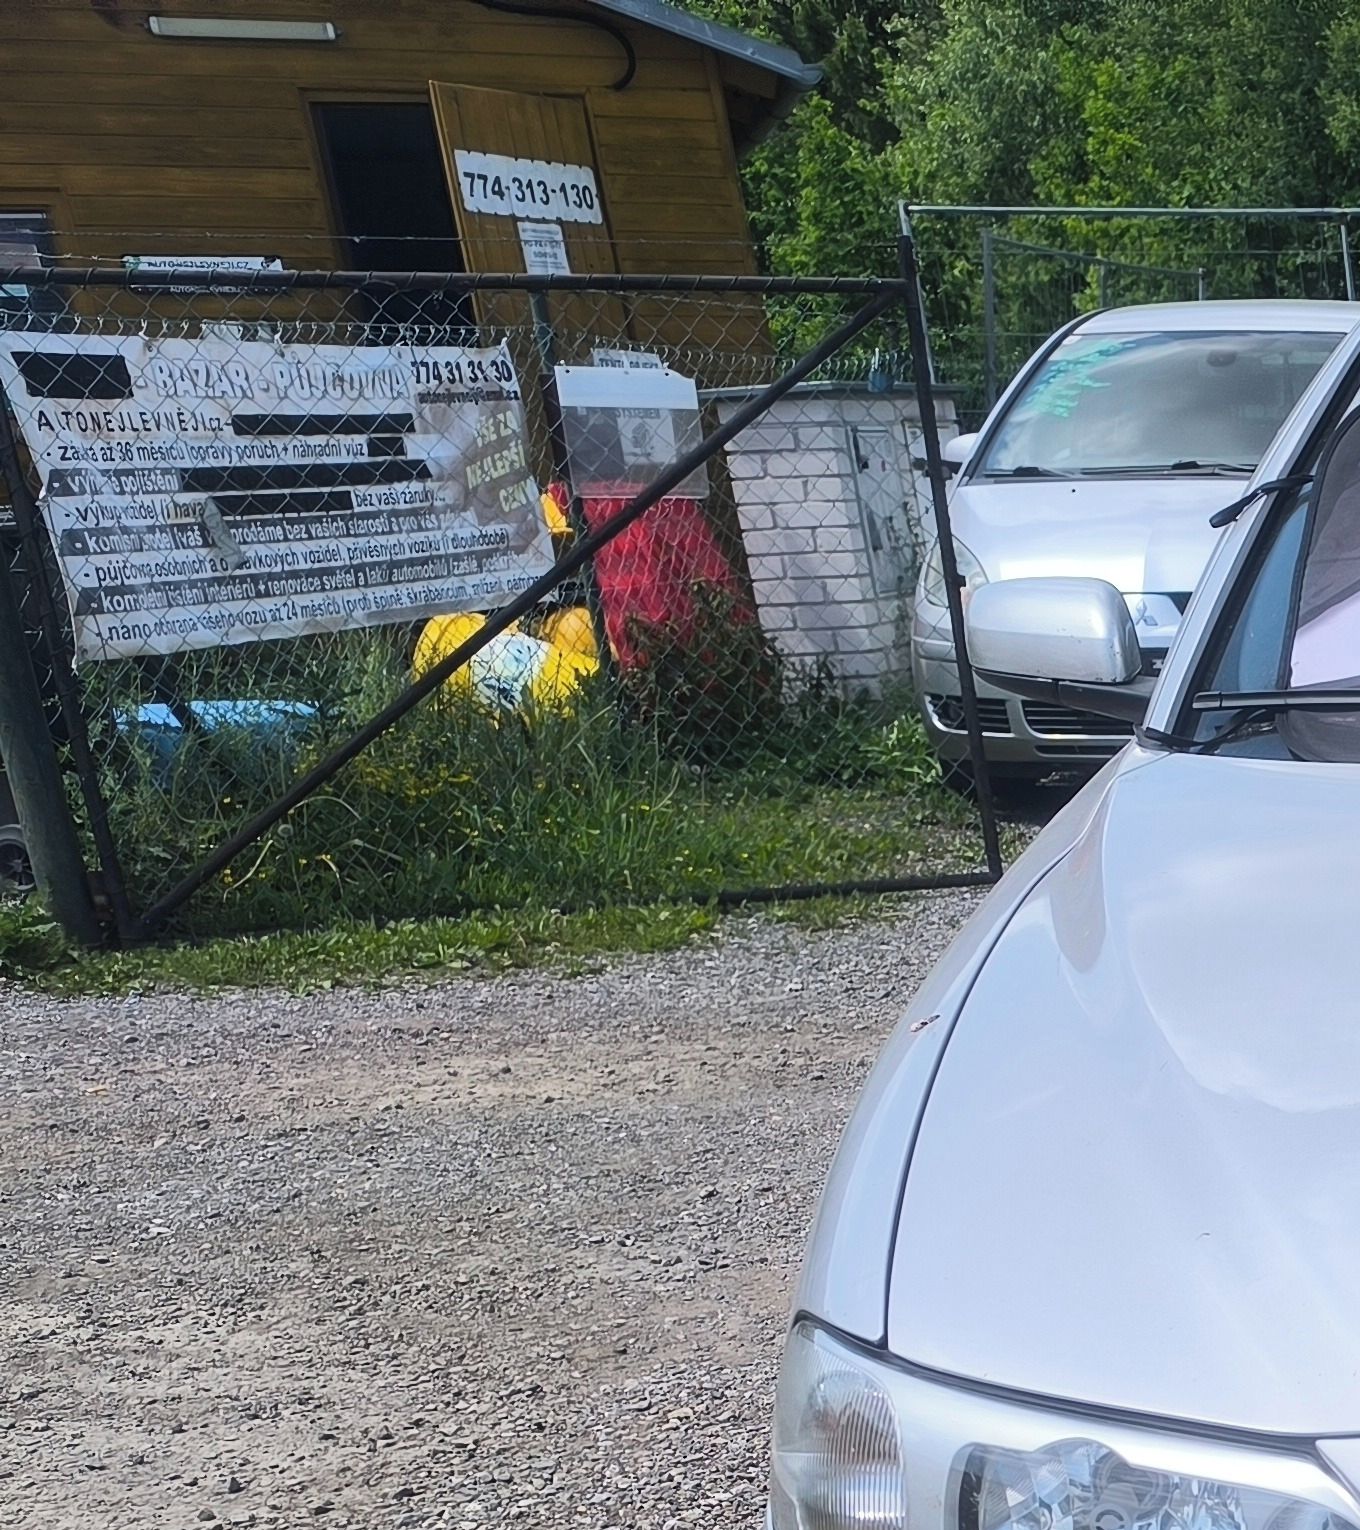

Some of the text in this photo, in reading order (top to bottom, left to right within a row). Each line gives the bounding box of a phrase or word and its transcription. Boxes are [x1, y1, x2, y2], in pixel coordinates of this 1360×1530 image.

[462, 171, 594, 210] 774-313-130
[150, 357, 254, 400] BAZAR
[411, 360, 512, 384] 774 31 31 30
[116, 441, 133, 461] 36
[235, 440, 280, 463] poruch
[292, 439, 341, 459] náhradní
[343, 438, 365, 457] vůz
[354, 489, 375, 507] bez
[283, 520, 308, 540] bez
[309, 517, 347, 538] vašich
[108, 623, 151, 641] nano
[238, 610, 267, 626] vozu
[283, 600, 298, 621] 24
